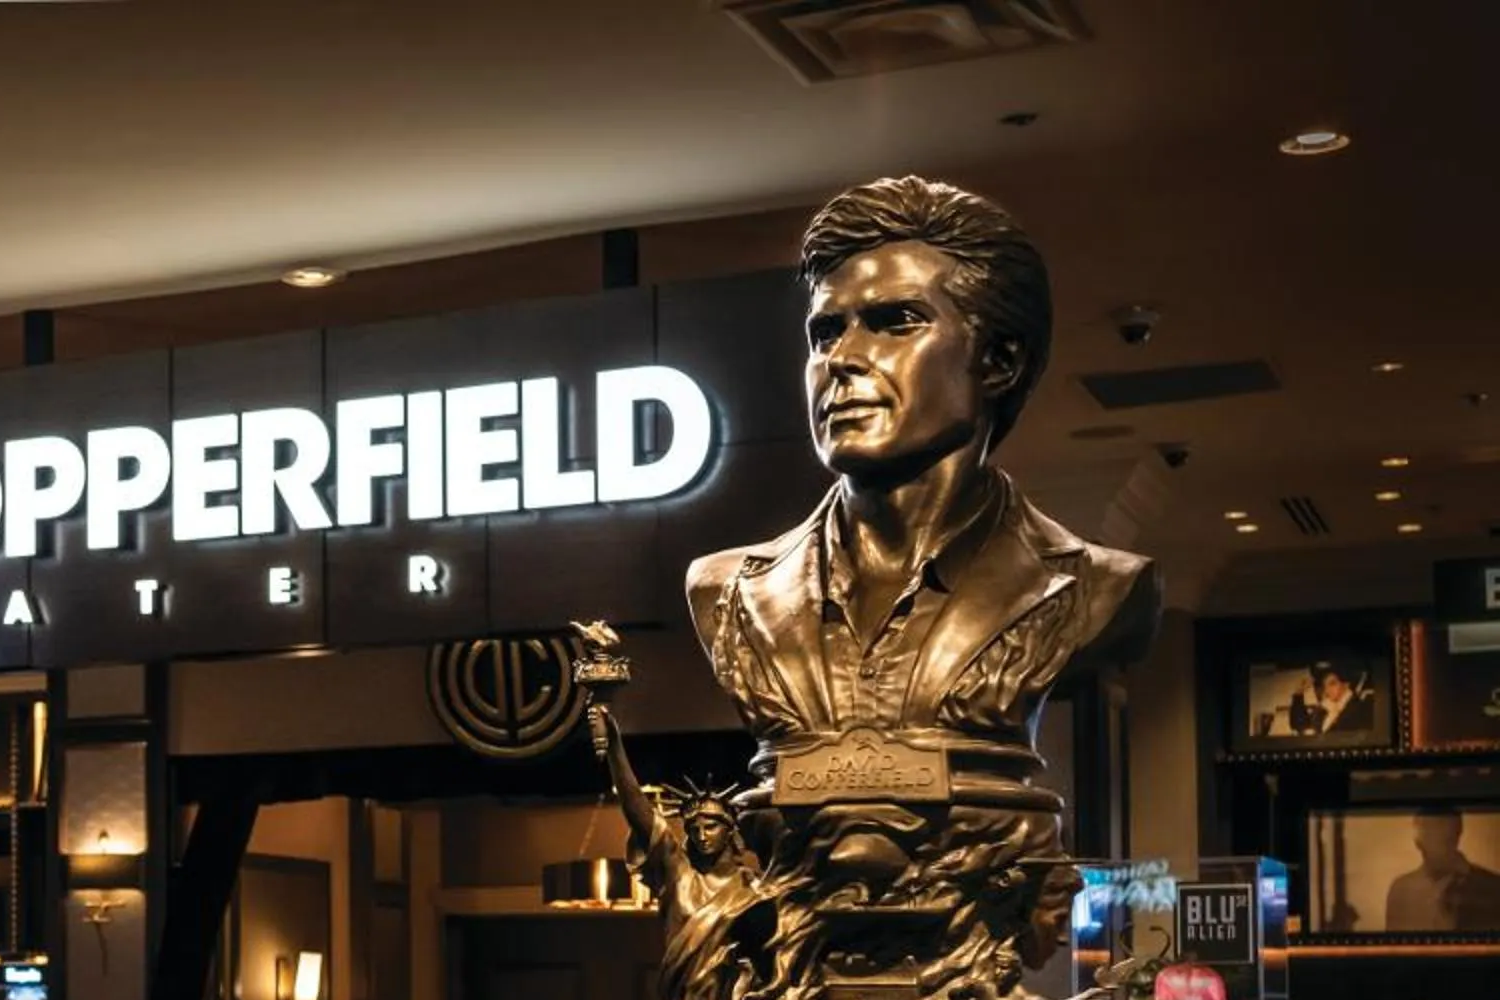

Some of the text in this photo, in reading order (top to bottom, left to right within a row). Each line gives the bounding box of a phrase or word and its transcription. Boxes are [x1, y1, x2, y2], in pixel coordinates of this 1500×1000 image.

[787, 767, 935, 791] COPPERFIELD
[1186, 895, 1236, 924] BLU
[1187, 925, 1237, 940] ALIEN
